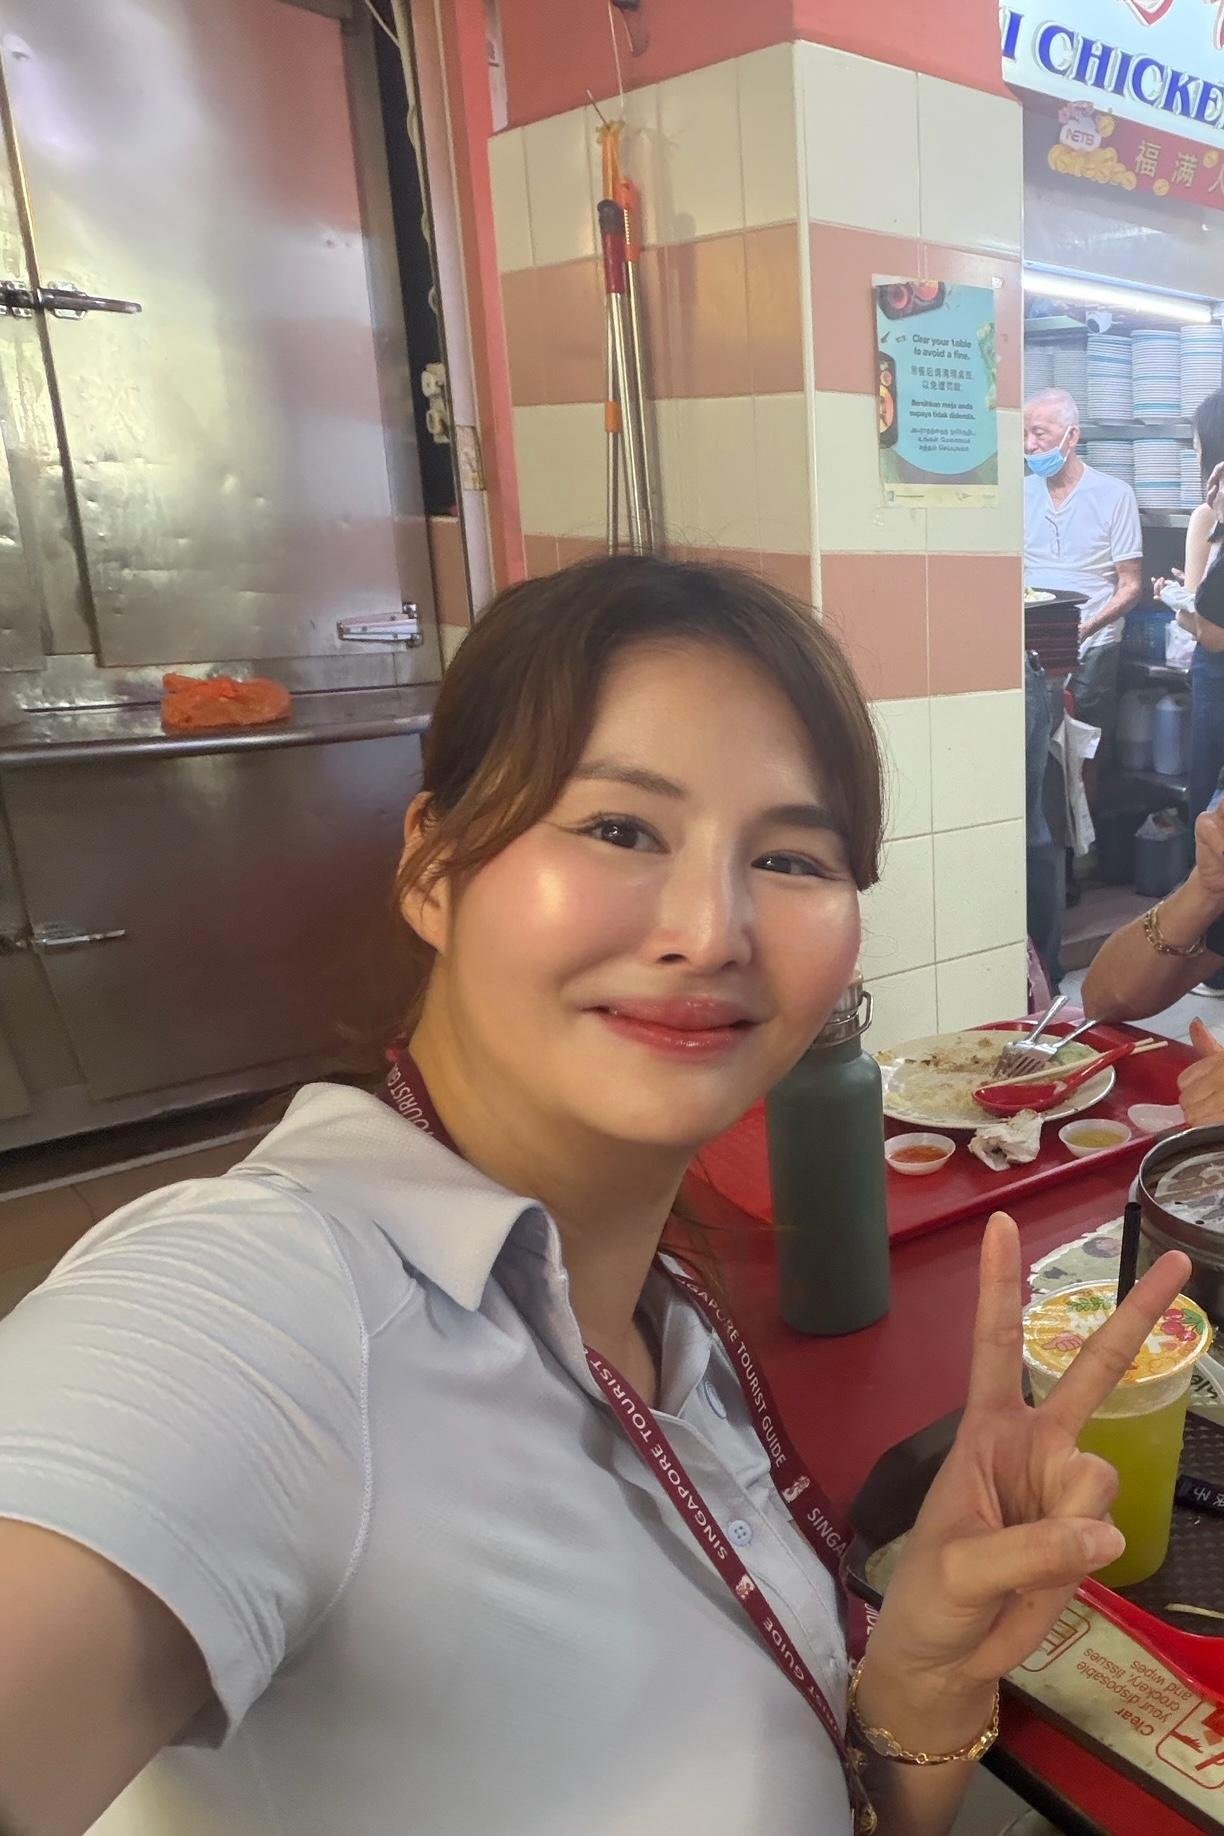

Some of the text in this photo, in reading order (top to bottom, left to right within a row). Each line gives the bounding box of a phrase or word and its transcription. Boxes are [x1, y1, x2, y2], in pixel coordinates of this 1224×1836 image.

[912, 334, 972, 349] Clear your table
[914, 346, 921, 356] to
[922, 348, 945, 358] avoid
[947, 351, 952, 359] a
[737, 1341, 767, 1413] TOURIST
[761, 1416, 787, 1468] GUIDE
[590, 1358, 727, 1560] SINGAPORE TOURIST
[807, 1507, 849, 1557] SINGA
[763, 1617, 805, 1681] GUIDE
[1076, 1661, 1172, 1723] your disposable
[1083, 1648, 1180, 1711] crockery, tissues
[1130, 1660, 1192, 1700] and wipes
[1115, 1707, 1154, 1736] Clear
